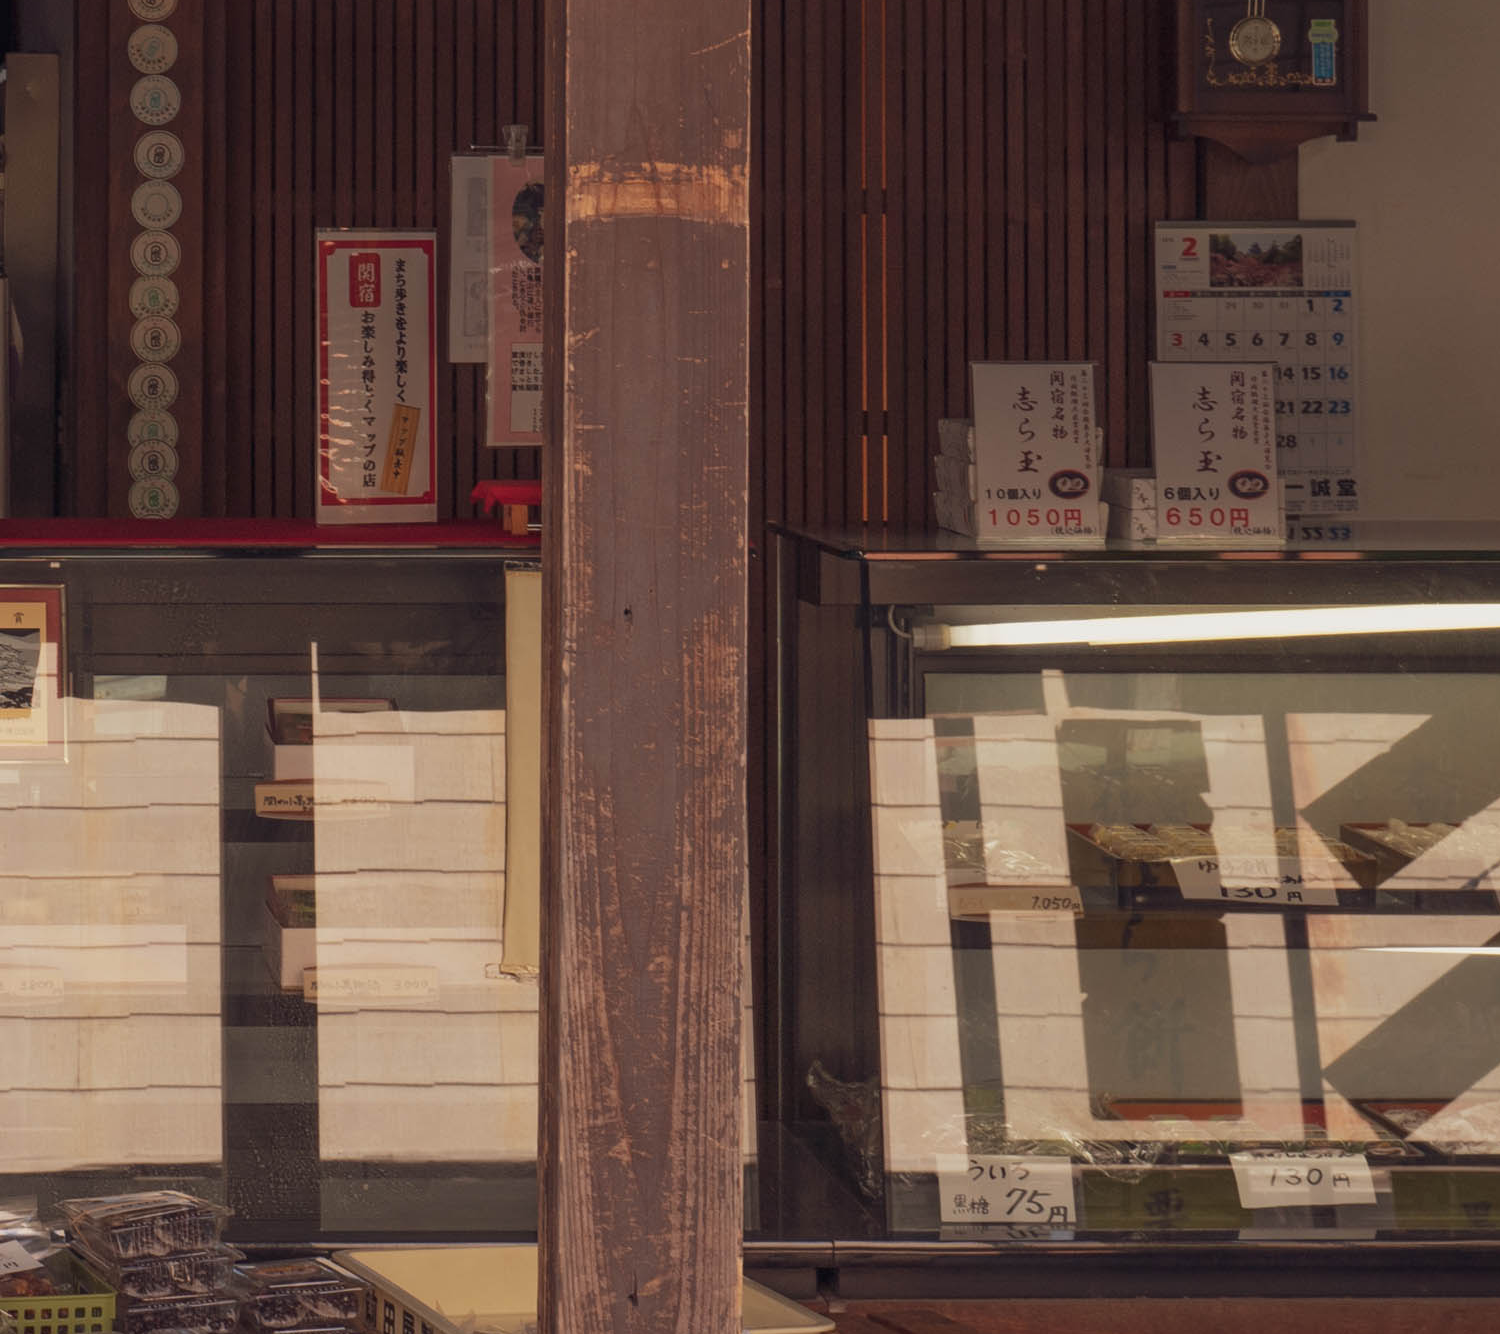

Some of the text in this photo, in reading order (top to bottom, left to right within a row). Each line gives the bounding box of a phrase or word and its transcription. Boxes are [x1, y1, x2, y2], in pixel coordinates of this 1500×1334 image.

[1182, 238, 1198, 257] 2
[1012, 386, 1042, 473] 志ら玉
[1192, 386, 1222, 473] 志ら玉
[985, 488, 1041, 500] 10個入り
[1164, 487, 1220, 501] 6個入り
[988, 509, 1082, 527] 1050円
[1166, 507, 1249, 527] 650円
[1269, 1169, 1351, 1189] 130円
